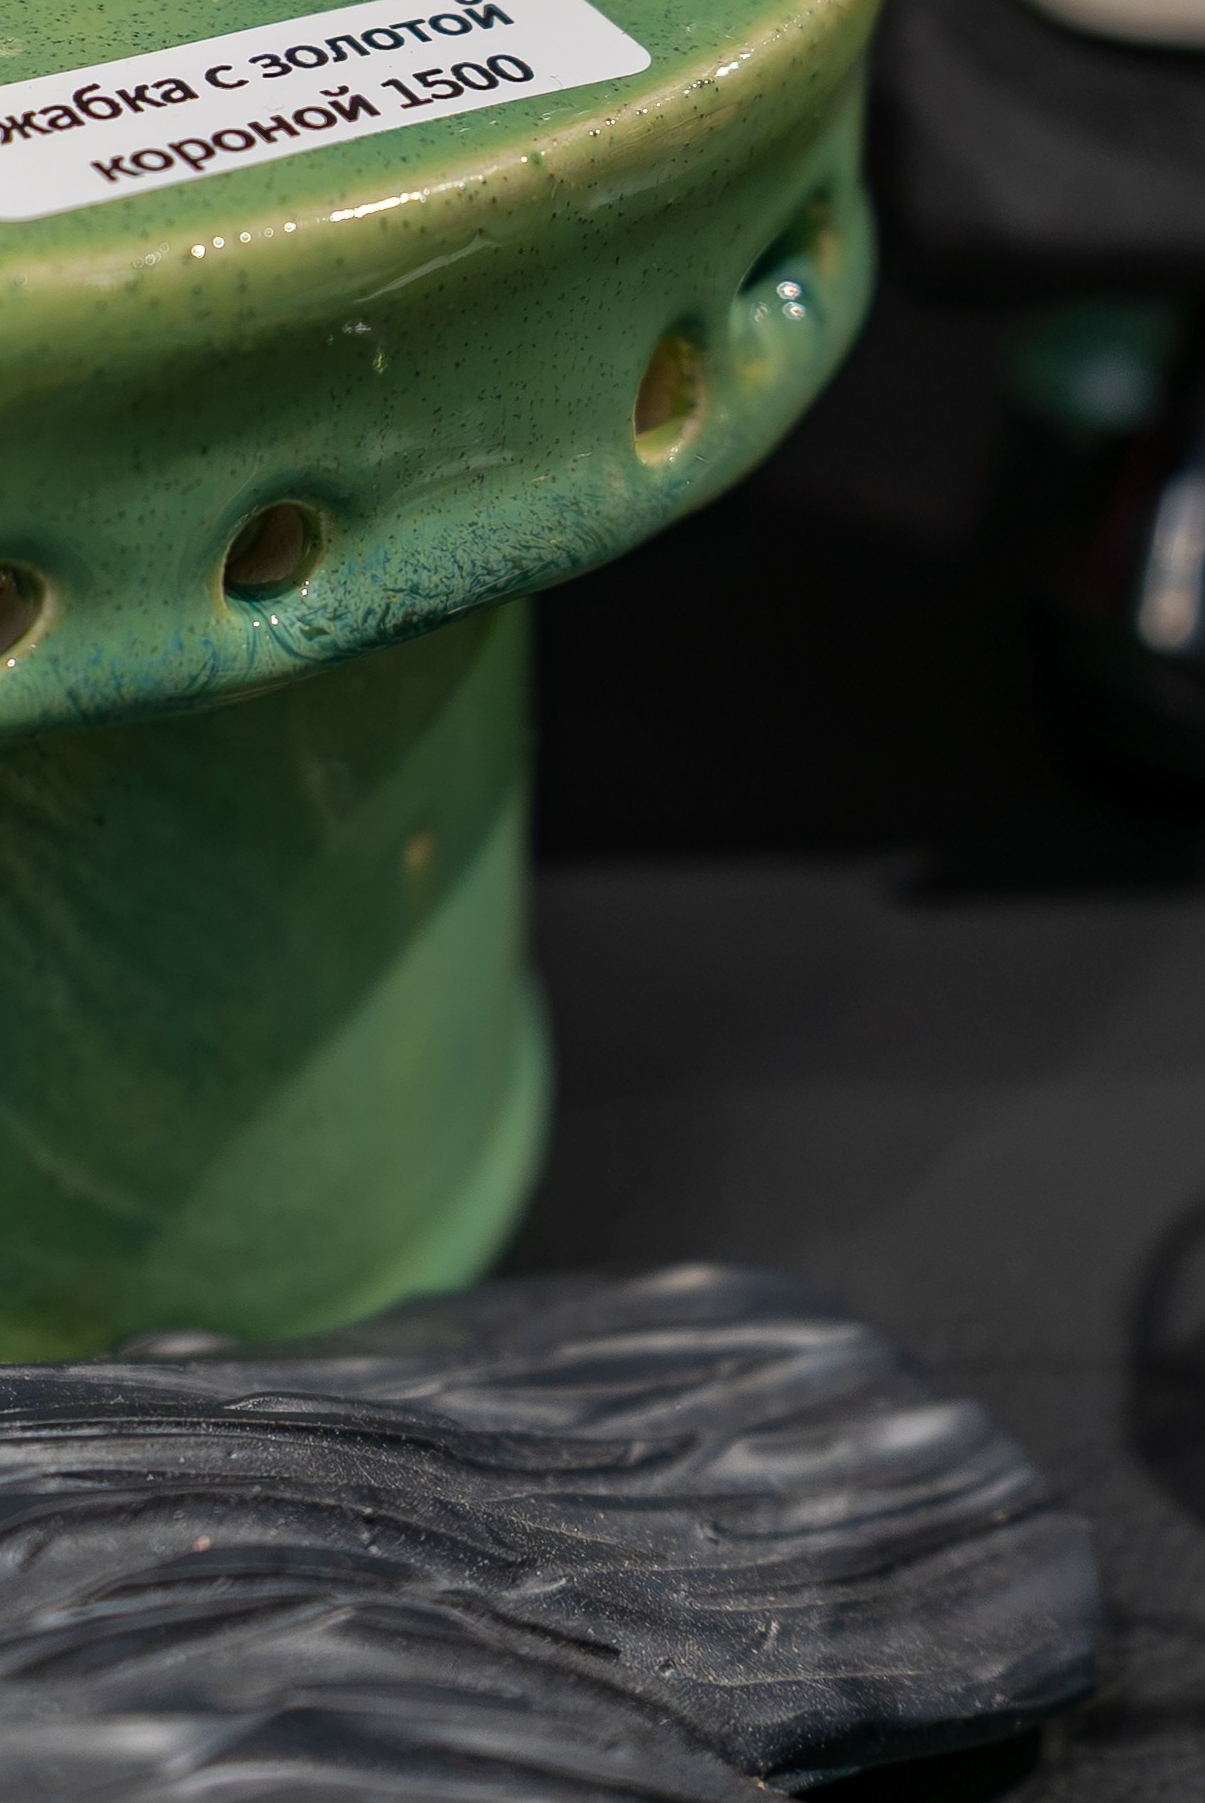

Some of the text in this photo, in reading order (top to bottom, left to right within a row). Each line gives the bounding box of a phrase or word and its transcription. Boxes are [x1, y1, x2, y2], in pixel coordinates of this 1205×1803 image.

[204, 64, 250, 91] с
[90, 53, 536, 183] короной 1500
